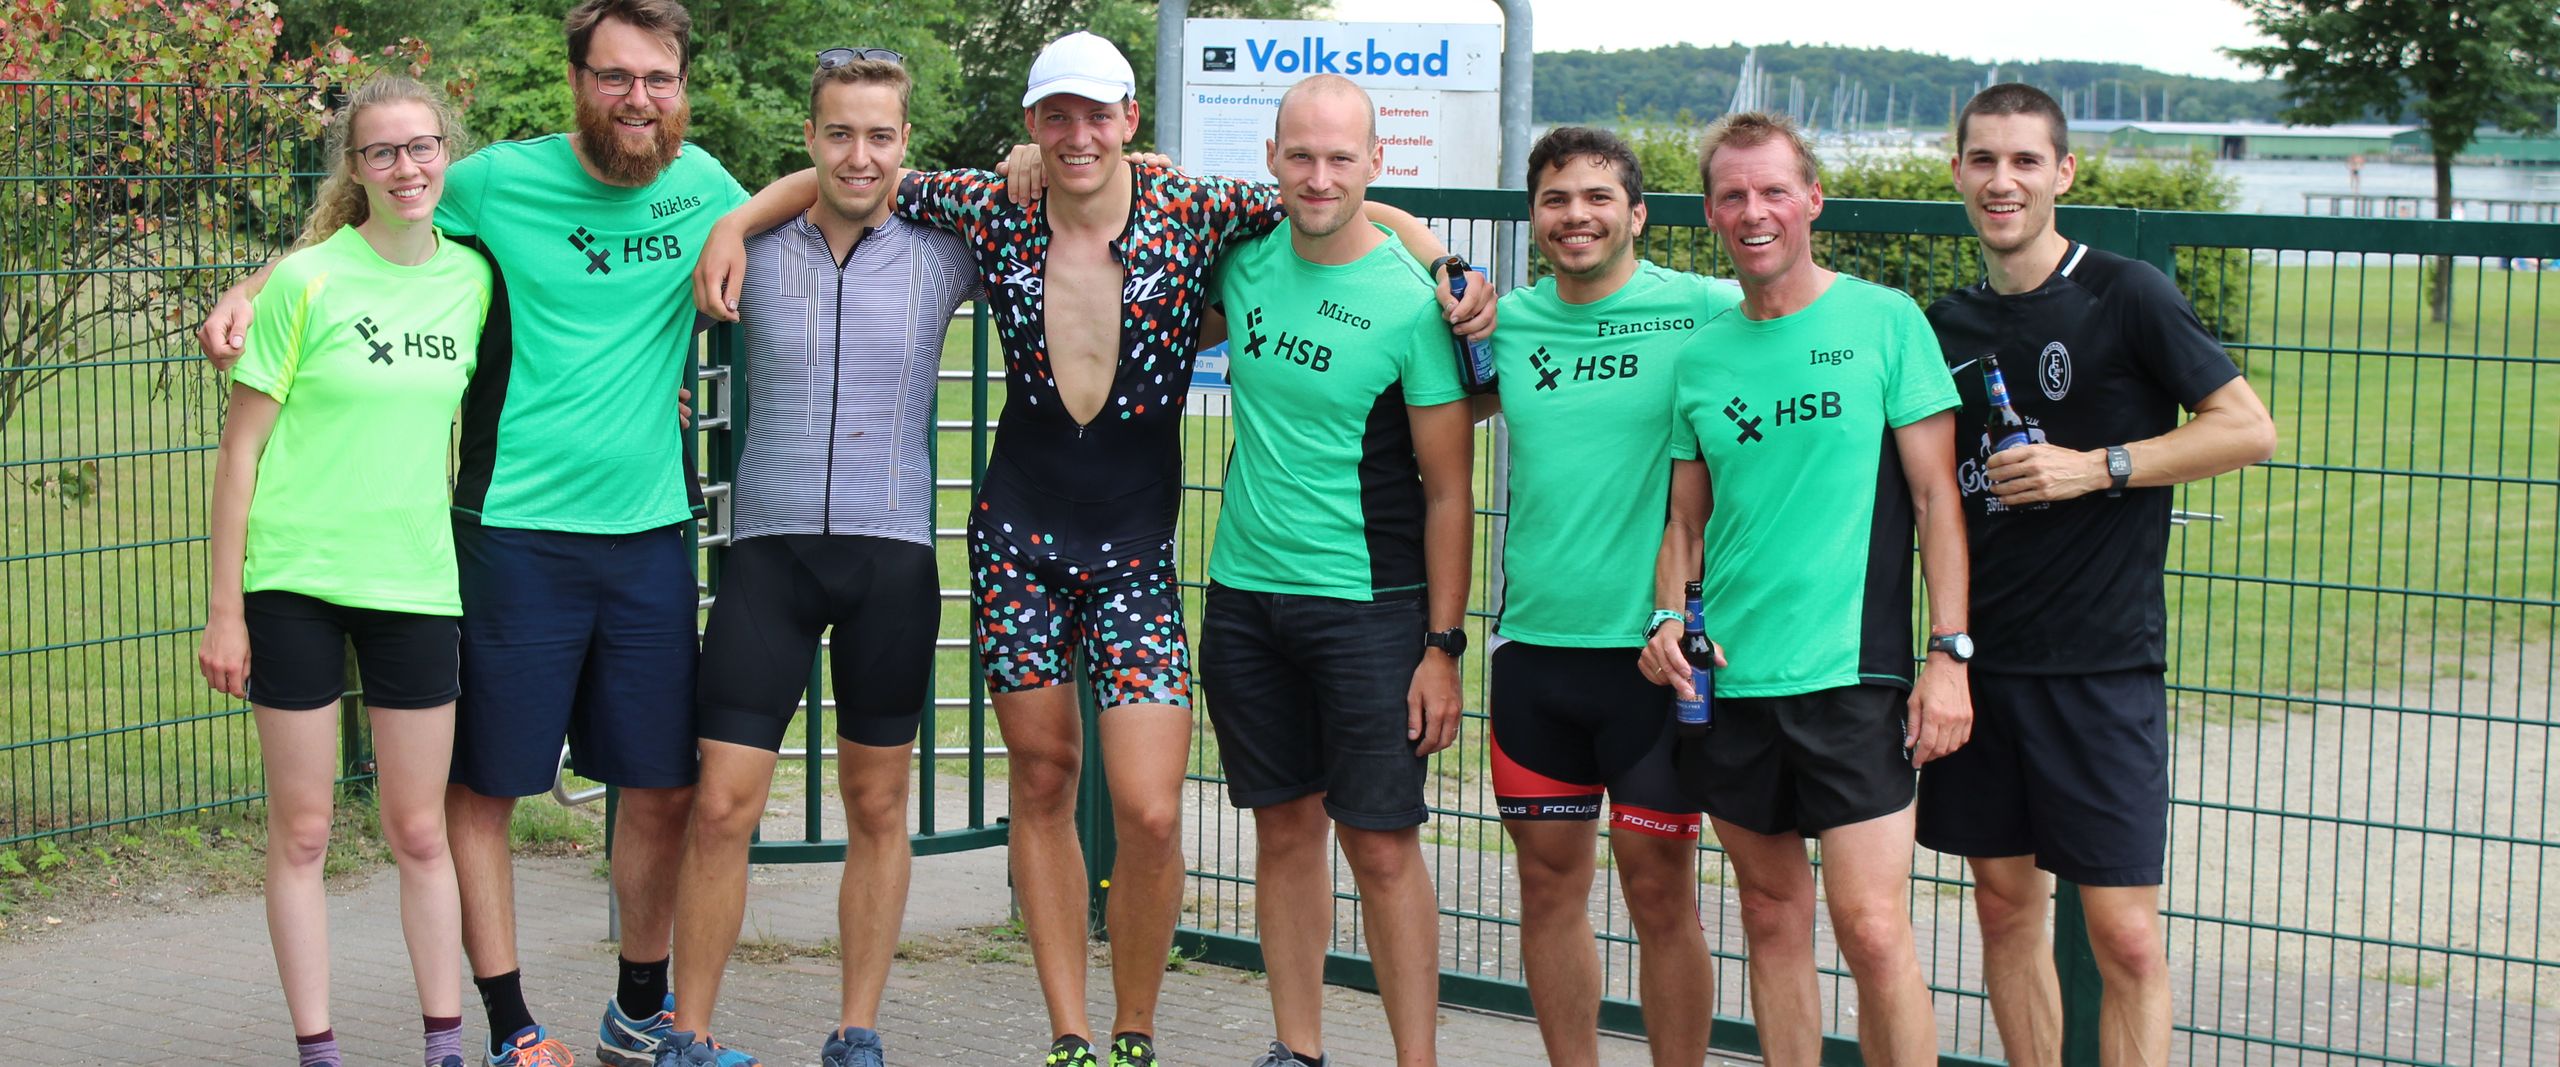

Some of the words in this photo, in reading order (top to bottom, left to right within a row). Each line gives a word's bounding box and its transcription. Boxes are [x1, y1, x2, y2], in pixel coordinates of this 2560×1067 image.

[1246, 37, 1449, 76] Volksbad
[1198, 94, 1281, 107] Badeordnung
[1380, 107, 1429, 117] Betreten
[1375, 134, 1433, 146] Badestelle
[1386, 166, 1418, 176] Hund
[650, 196, 701, 219] Niklas
[624, 235, 682, 263] HSB
[1317, 299, 1371, 330] Mirco
[1597, 317, 1695, 337] Francisco
[404, 333, 457, 361] HSB
[1274, 331, 1332, 372] HSB
[1810, 349, 1854, 366] Ingo
[1573, 354, 1639, 381] HSB
[1775, 391, 1842, 427] HSB
[1499, 806, 1527, 814] CUS
[1542, 804, 1598, 814] FOCUS
[1623, 814, 1678, 833] FOCUS
